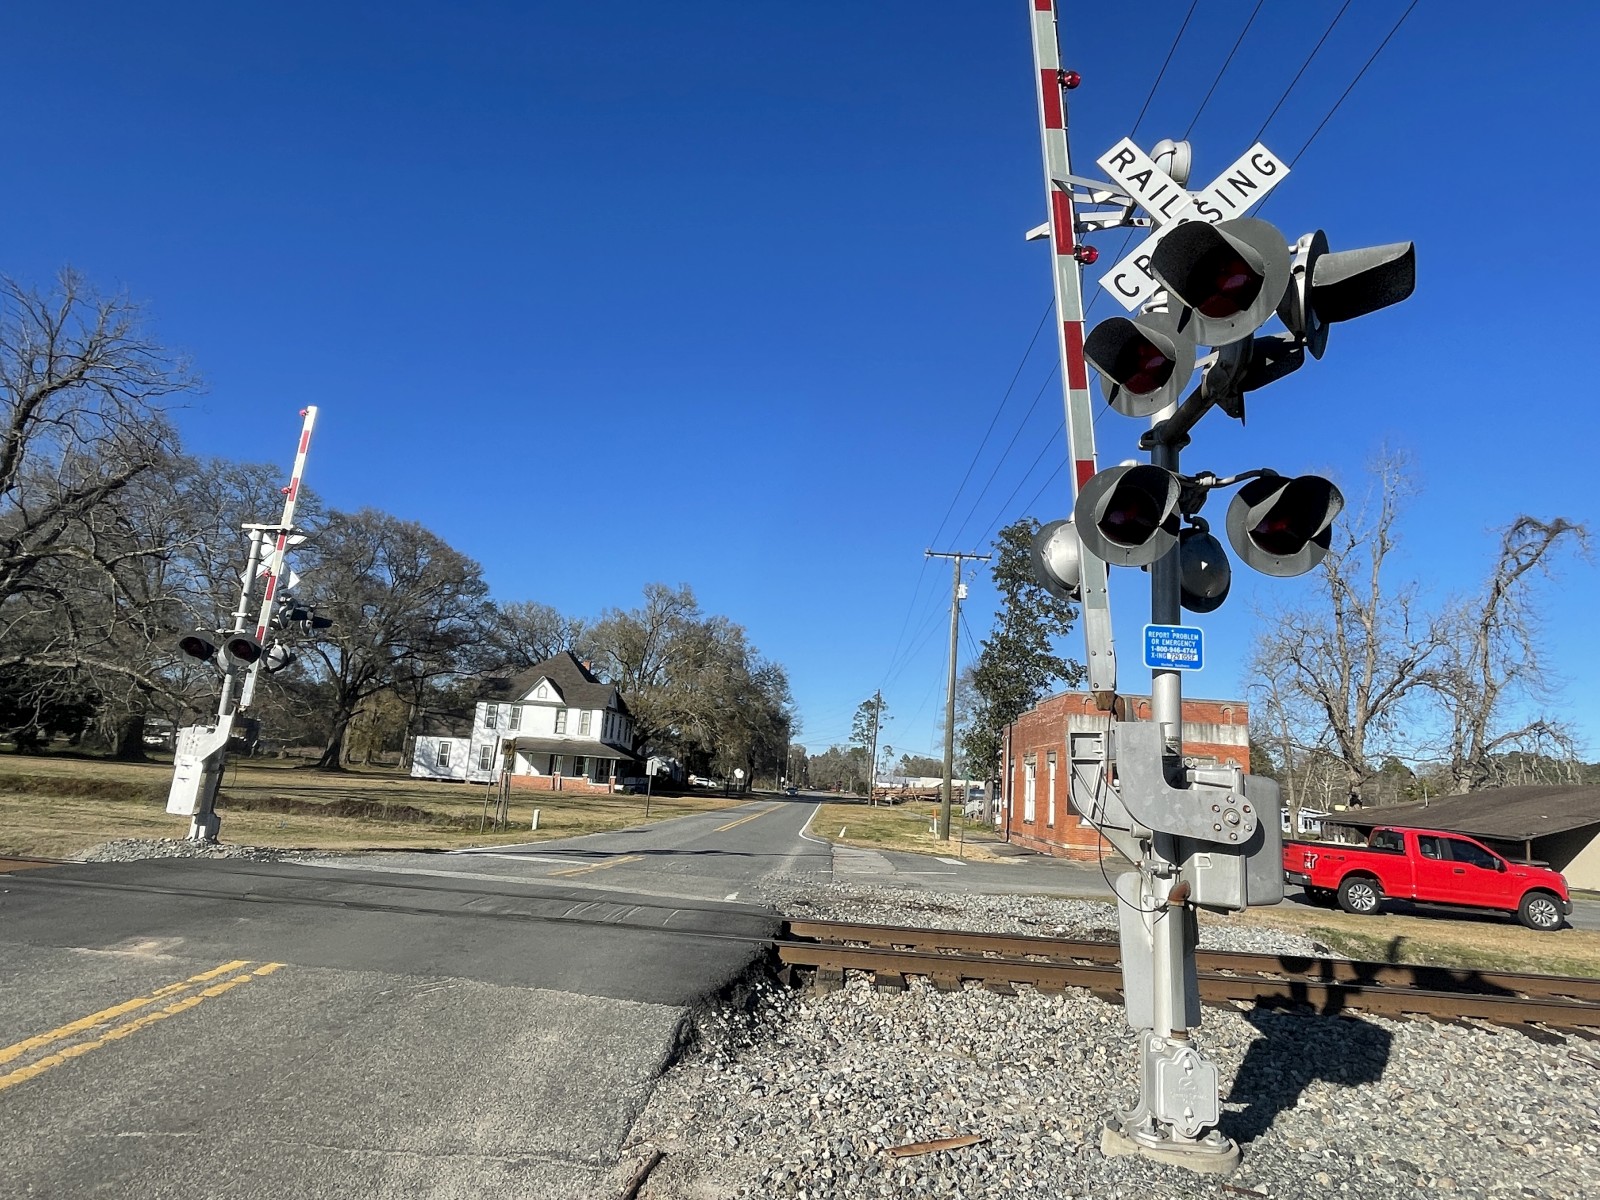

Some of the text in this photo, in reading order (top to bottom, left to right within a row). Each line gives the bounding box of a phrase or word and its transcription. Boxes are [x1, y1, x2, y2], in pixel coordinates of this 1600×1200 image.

[1108, 146, 1180, 219] RAIL
[1113, 153, 1277, 298] CRSING
[1172, 632, 1199, 640] PROBLEM
[1161, 639, 1196, 647] EMERGENCY
[1151, 645, 1197, 654] 1-800-946-4744
